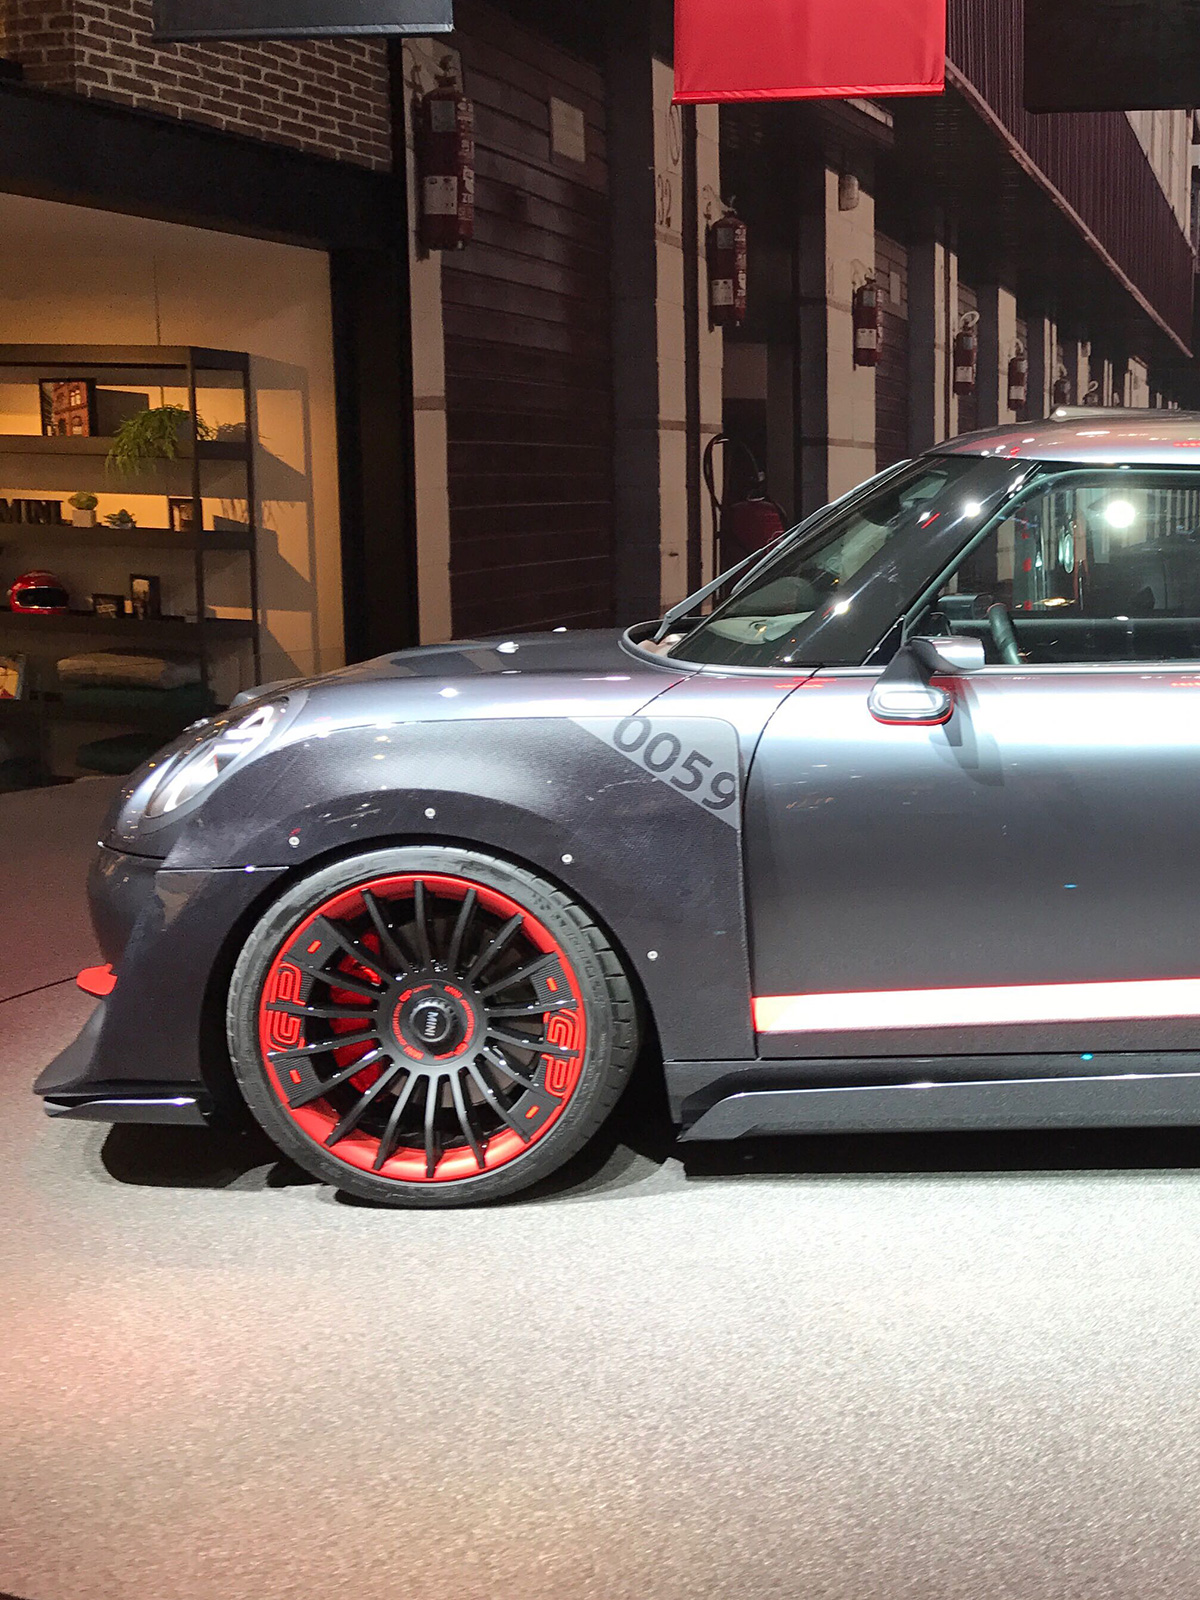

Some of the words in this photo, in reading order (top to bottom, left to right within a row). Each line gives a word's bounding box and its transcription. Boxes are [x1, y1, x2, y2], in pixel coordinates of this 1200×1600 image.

[613, 716, 737, 810] 0059
[267, 962, 306, 1053] GP
[424, 1011, 439, 1036] MINI
[541, 1008, 579, 1097] GP
